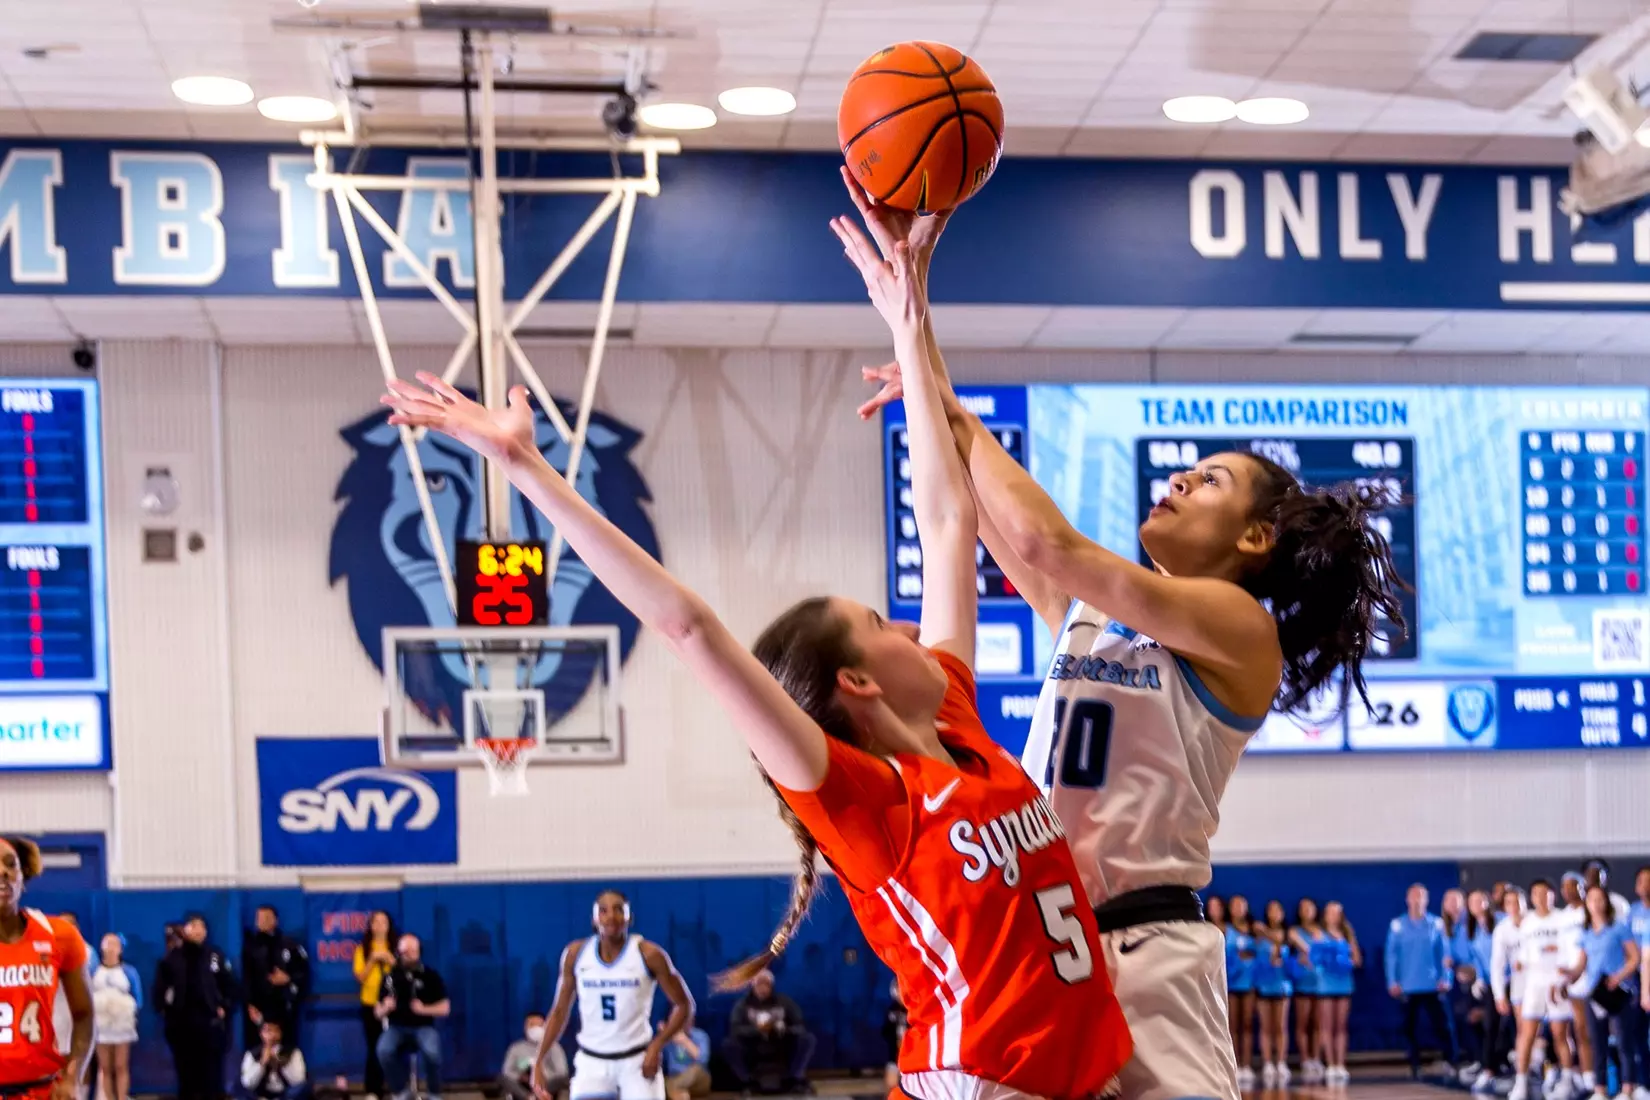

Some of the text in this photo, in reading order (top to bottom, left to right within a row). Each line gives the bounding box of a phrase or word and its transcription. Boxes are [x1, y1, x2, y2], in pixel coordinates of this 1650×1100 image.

[1188, 169, 1442, 261] ONLY
[1139, 397, 1408, 426] TEAM COMPARISON
[478, 544, 543, 577] 6:24
[473, 574, 533, 625] 25
[278, 789, 414, 834] SNY
[1033, 882, 1093, 985] 5
[0, 1001, 42, 1044] 24
[601, 994, 617, 1021] 5
